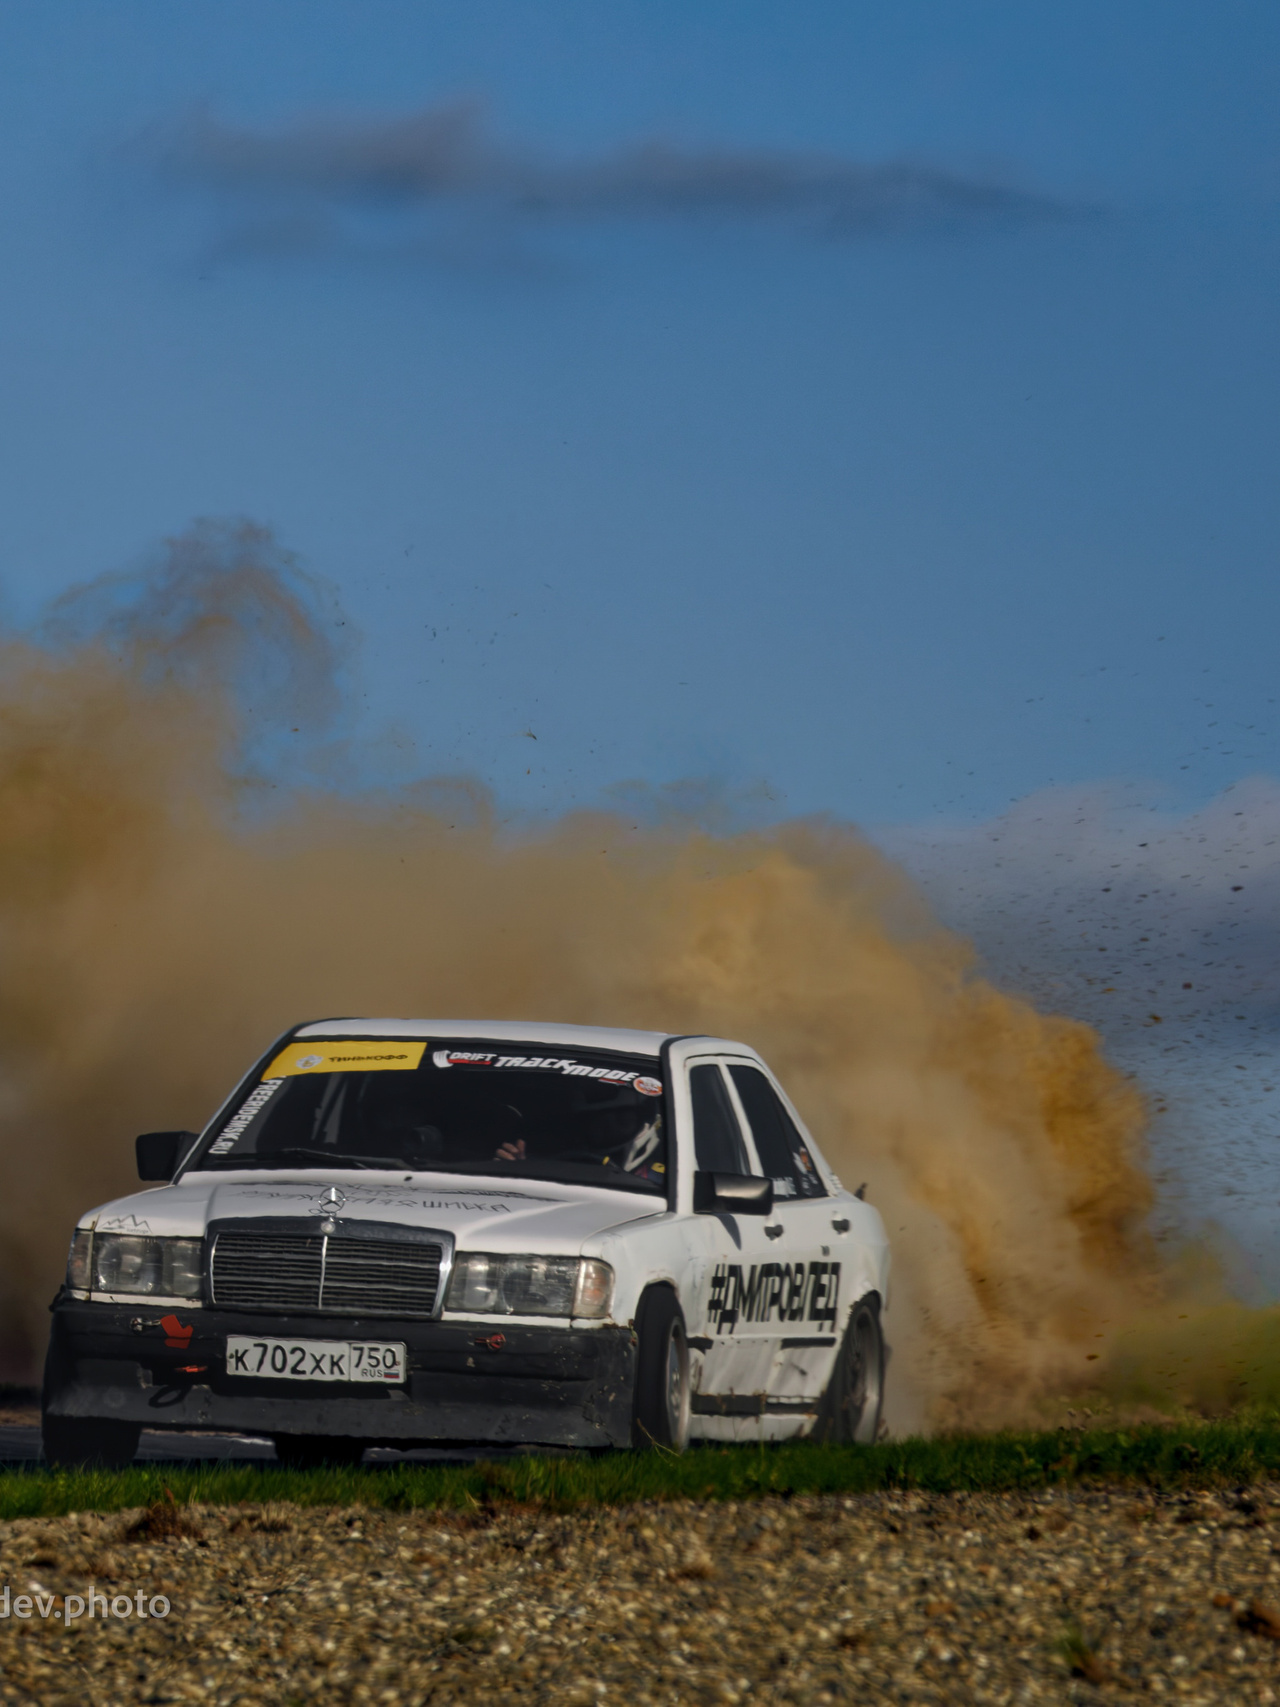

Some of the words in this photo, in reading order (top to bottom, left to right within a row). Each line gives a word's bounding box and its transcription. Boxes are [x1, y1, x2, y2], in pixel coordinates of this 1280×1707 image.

[449, 1051, 498, 1062] DRIFT
[352, 1346, 397, 1369] 750
[361, 1368, 383, 1378] RUS
